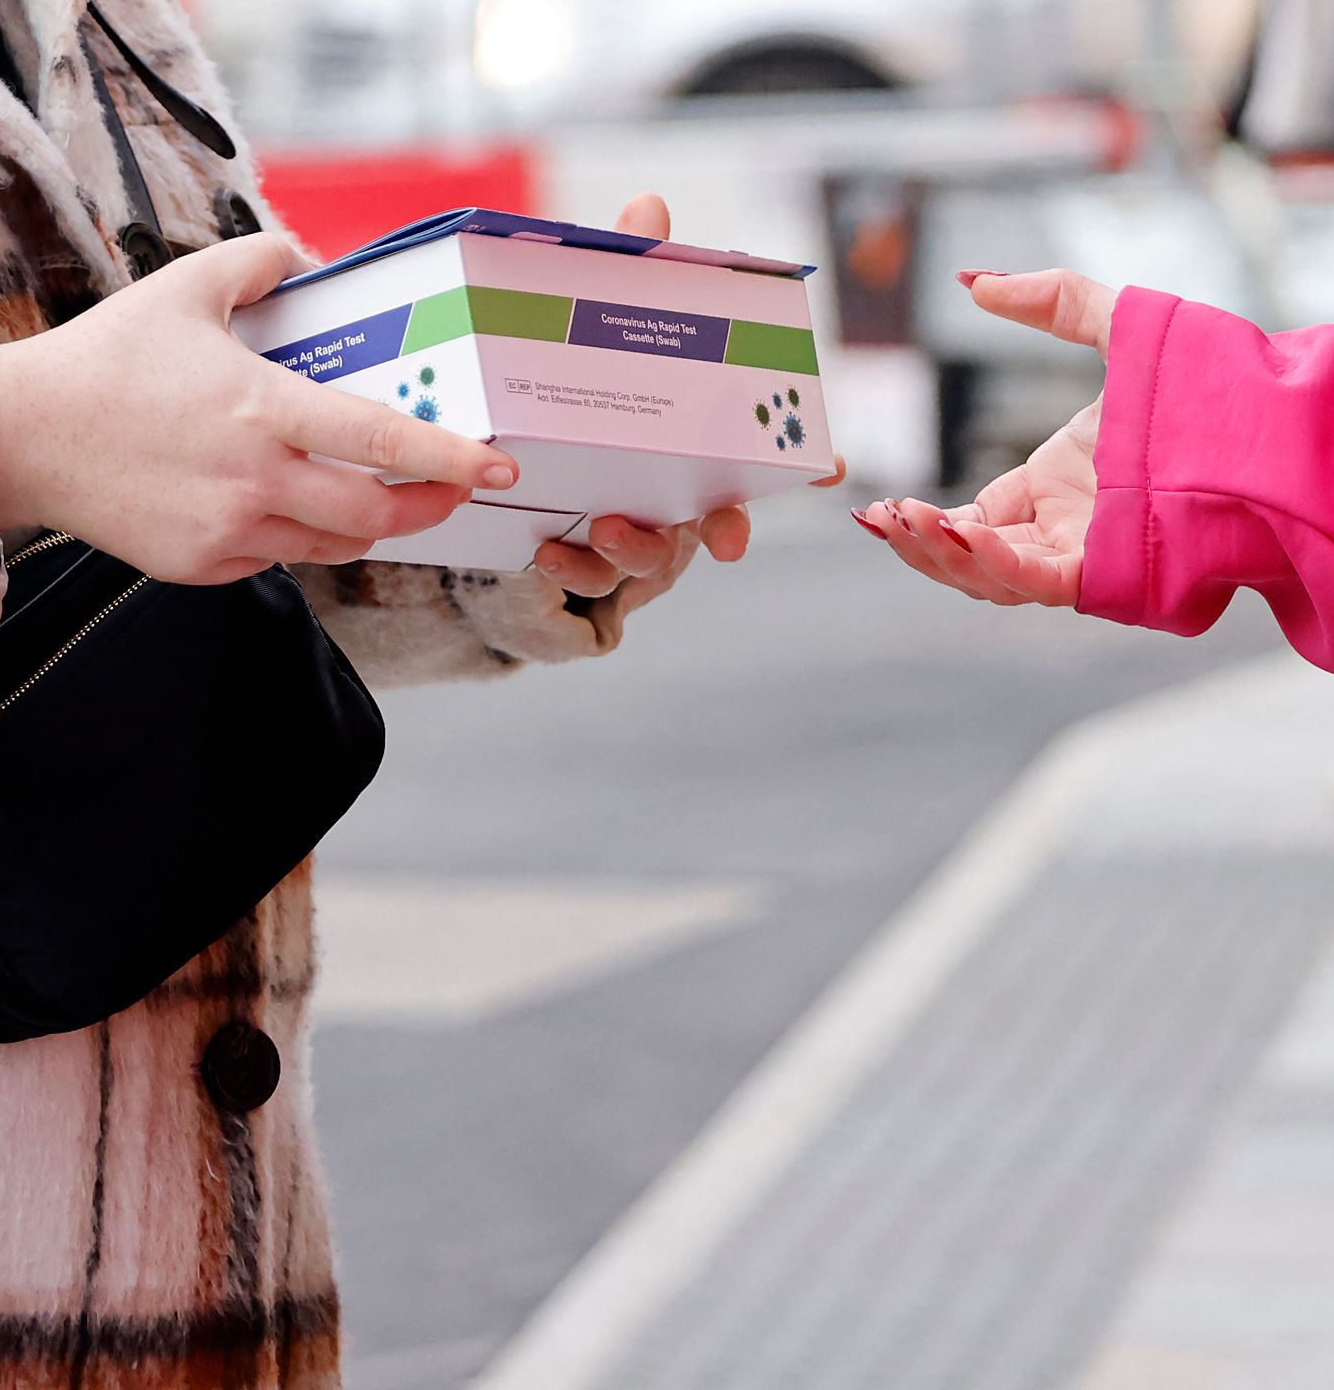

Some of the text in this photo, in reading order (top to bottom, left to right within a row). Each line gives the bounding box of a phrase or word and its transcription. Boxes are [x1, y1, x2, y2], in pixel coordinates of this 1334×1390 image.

[601, 313, 697, 335] Coronavirus Ag Rapid Test
[300, 352, 314, 363] Ag
[315, 339, 343, 356] Rapid
[344, 332, 365, 347] Test
[622, 330, 681, 350] Cassette (Swab)
[310, 355, 343, 377] (Swab)
[562, 385, 595, 397] International
[595, 389, 617, 401] Holding
[632, 393, 650, 403] GmbH
[637, 405, 662, 417] Germany
